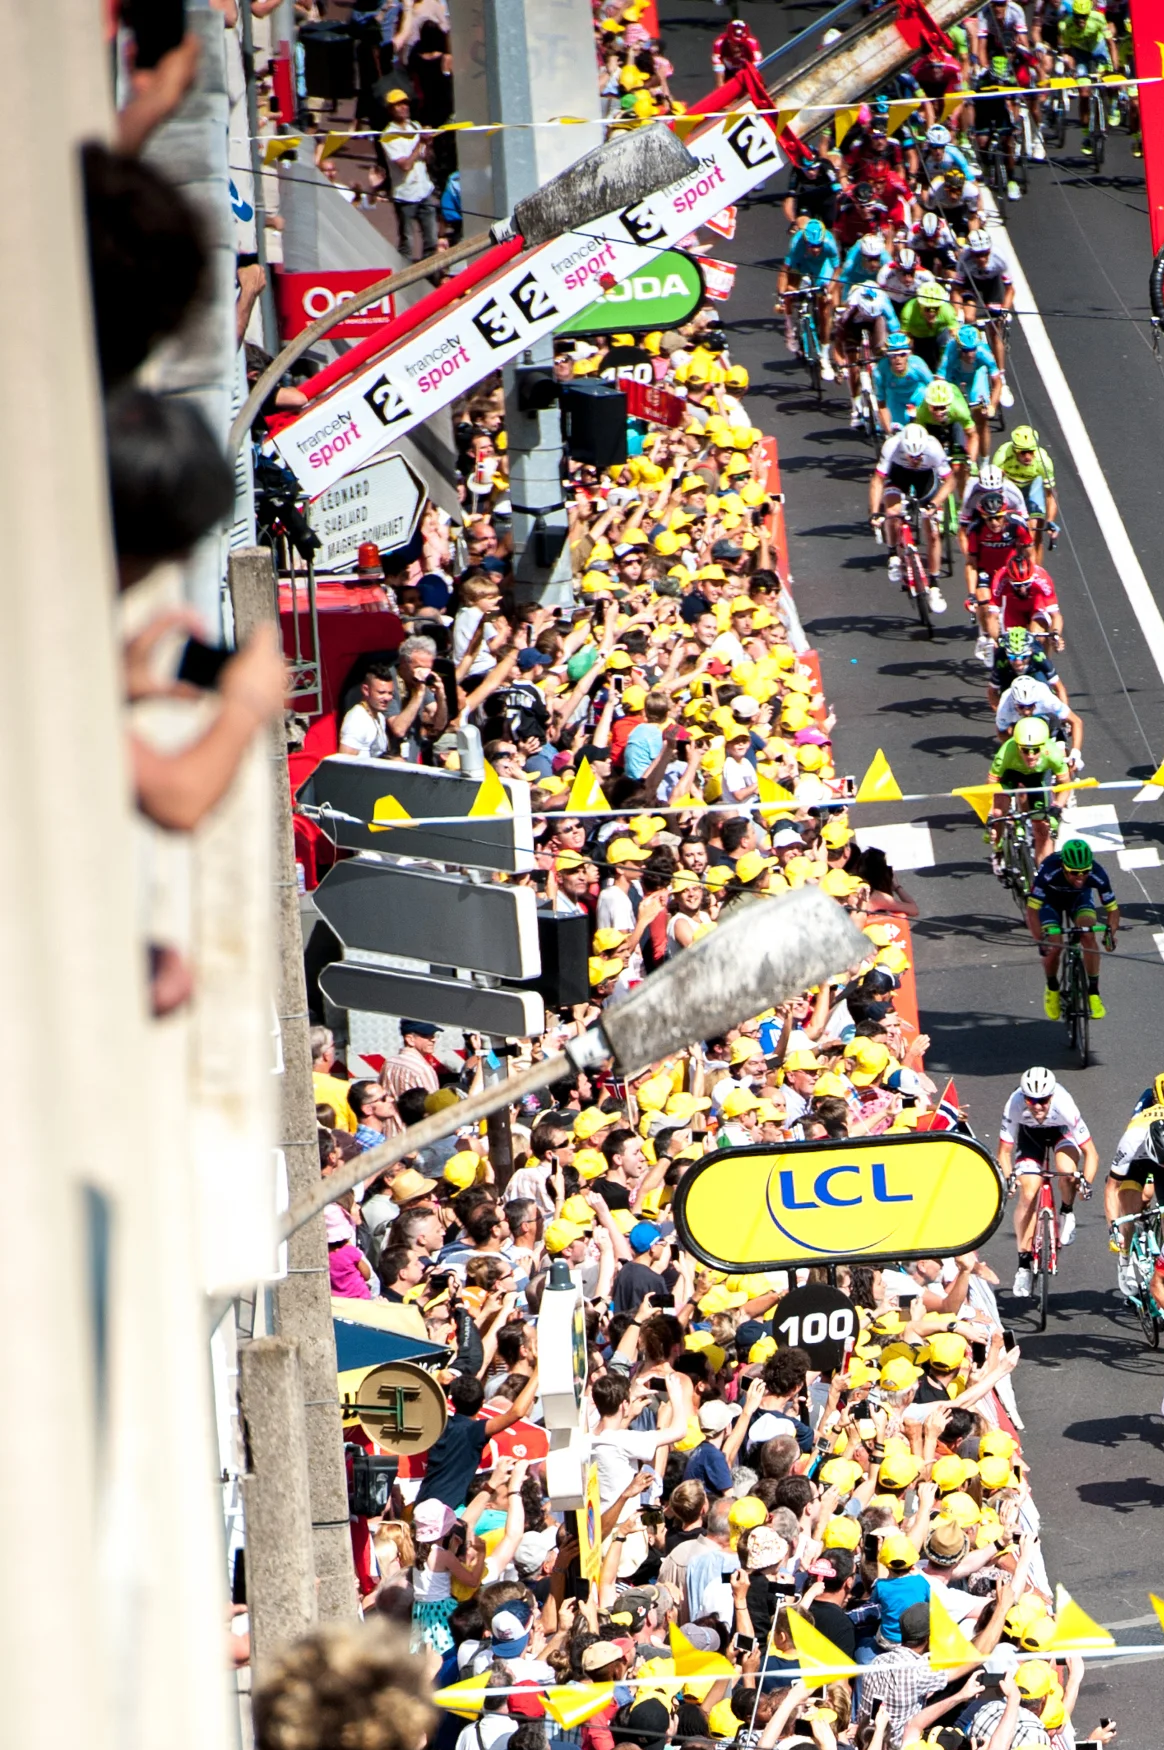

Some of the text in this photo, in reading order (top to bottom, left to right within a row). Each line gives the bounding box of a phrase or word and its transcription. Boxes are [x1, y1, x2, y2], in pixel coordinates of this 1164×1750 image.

[672, 164, 726, 214] sport
[550, 232, 609, 276] francetv
[563, 242, 617, 291] sport
[597, 273, 691, 304] ODA
[403, 333, 462, 378] francetv
[416, 345, 471, 393] sport
[295, 410, 353, 455] francetv
[308, 421, 362, 469] sport
[779, 1163, 914, 1210] LCL
[779, 1308, 854, 1346] 100
